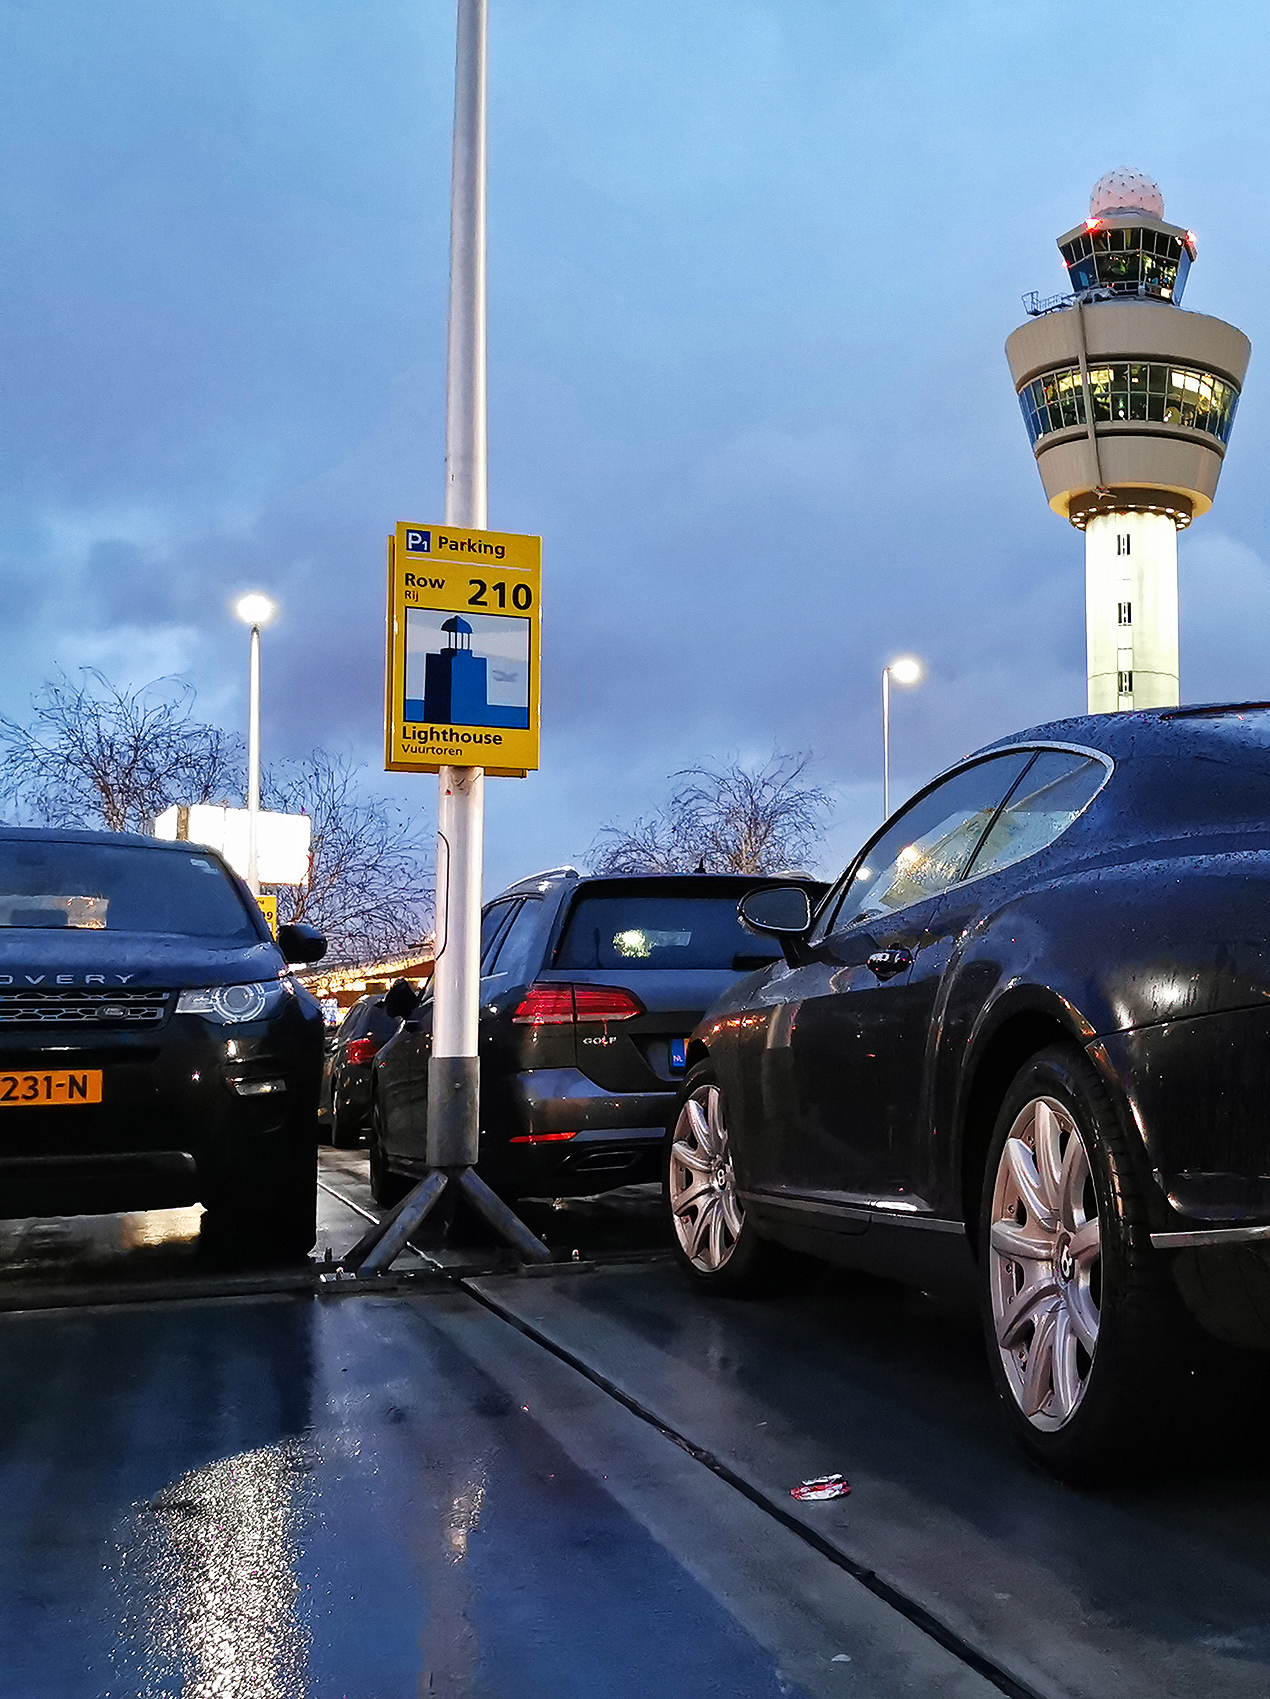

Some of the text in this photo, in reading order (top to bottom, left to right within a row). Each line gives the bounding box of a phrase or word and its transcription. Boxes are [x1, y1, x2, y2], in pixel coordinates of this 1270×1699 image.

[438, 535, 505, 558] Parking
[404, 572, 533, 611] Row 210
[404, 590, 419, 603] Rij
[402, 725, 503, 745] Lighthouse
[401, 743, 463, 757] Vuurtoren
[0, 1074, 88, 1101] 231-N
